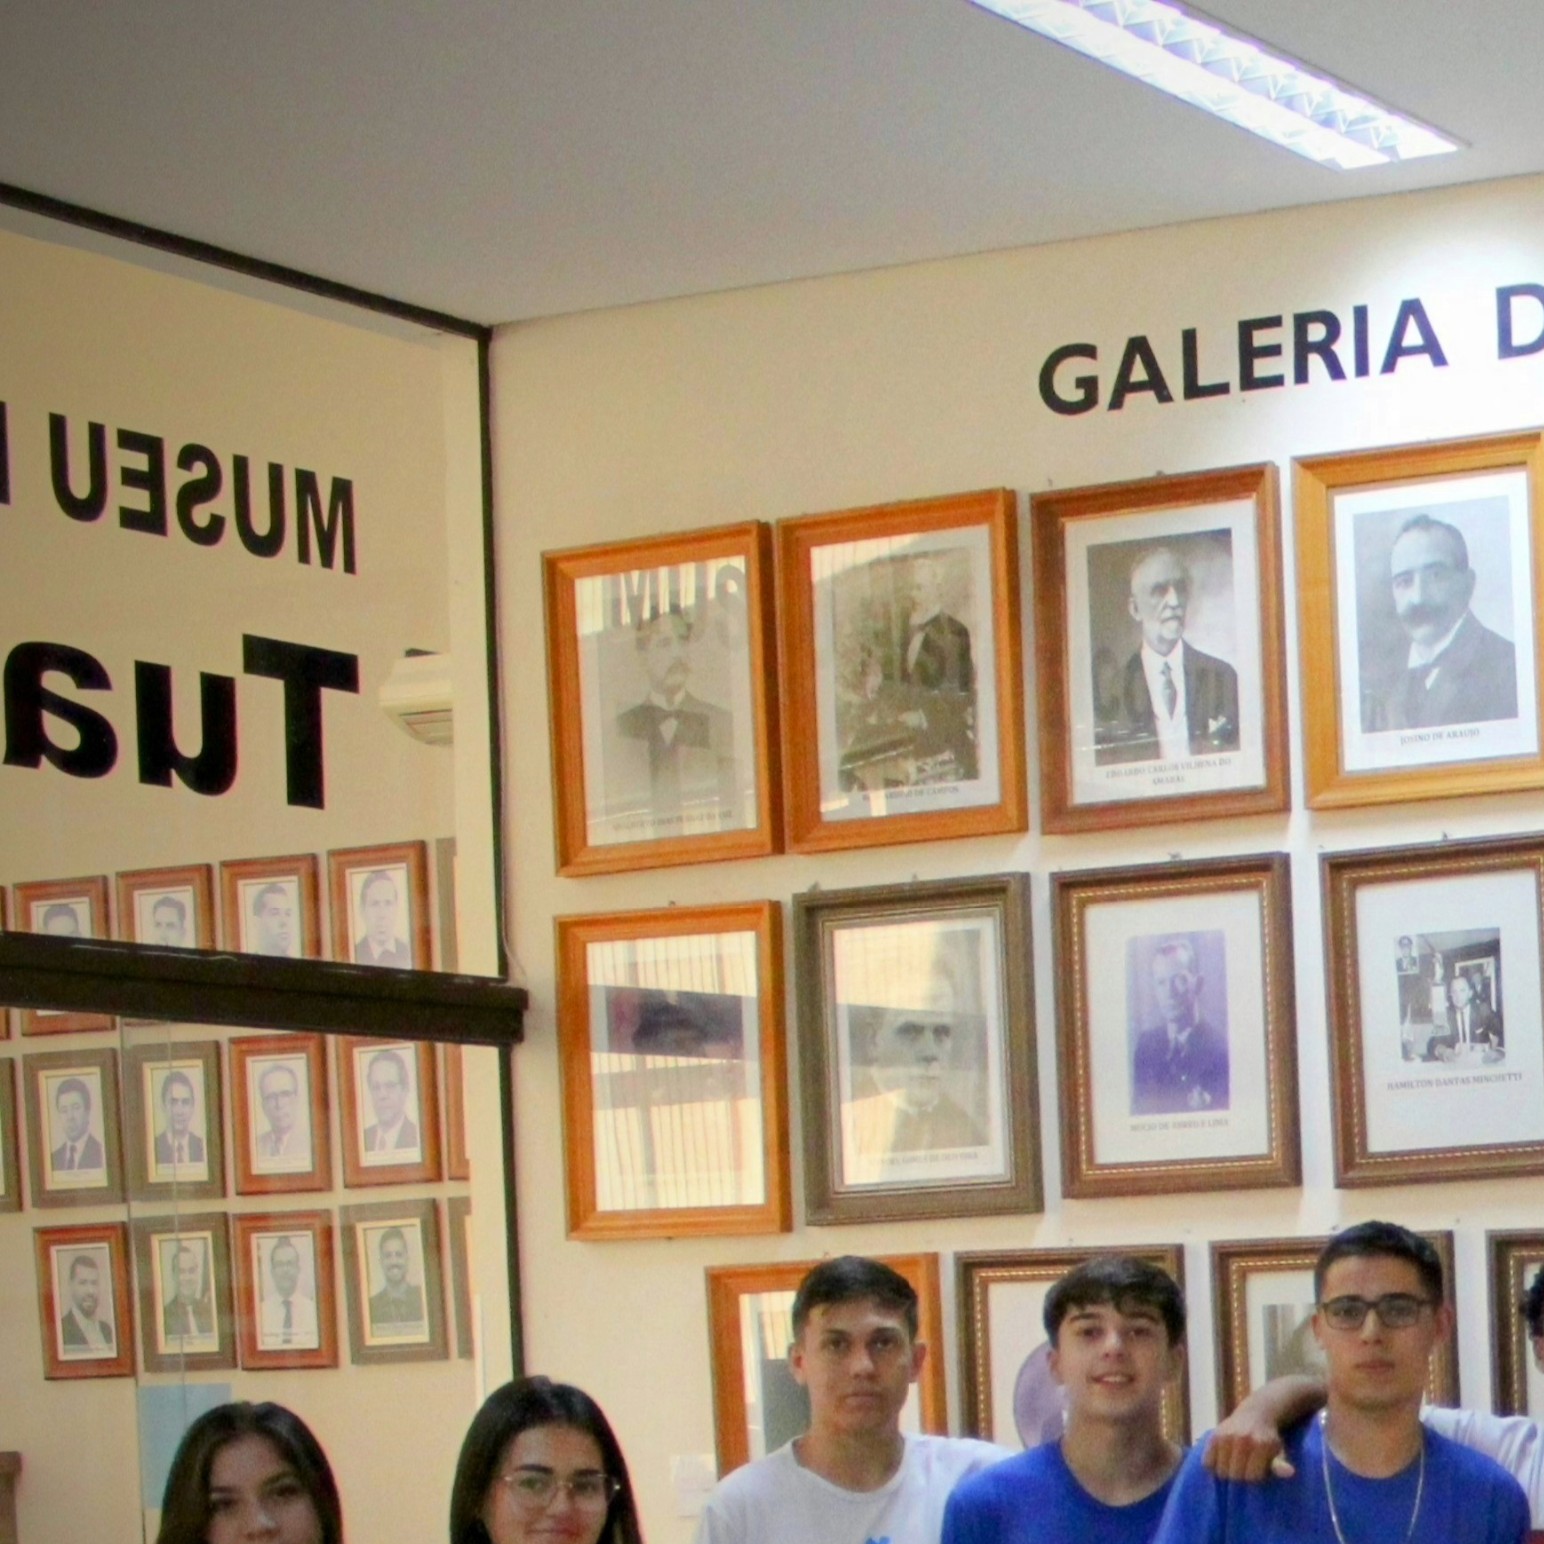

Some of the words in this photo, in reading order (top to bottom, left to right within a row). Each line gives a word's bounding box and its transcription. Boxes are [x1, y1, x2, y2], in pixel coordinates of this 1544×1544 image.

[1038, 297, 1449, 416] GALERIA
[1432, 731, 1444, 741] DE
[1218, 757, 1232, 768] DO
